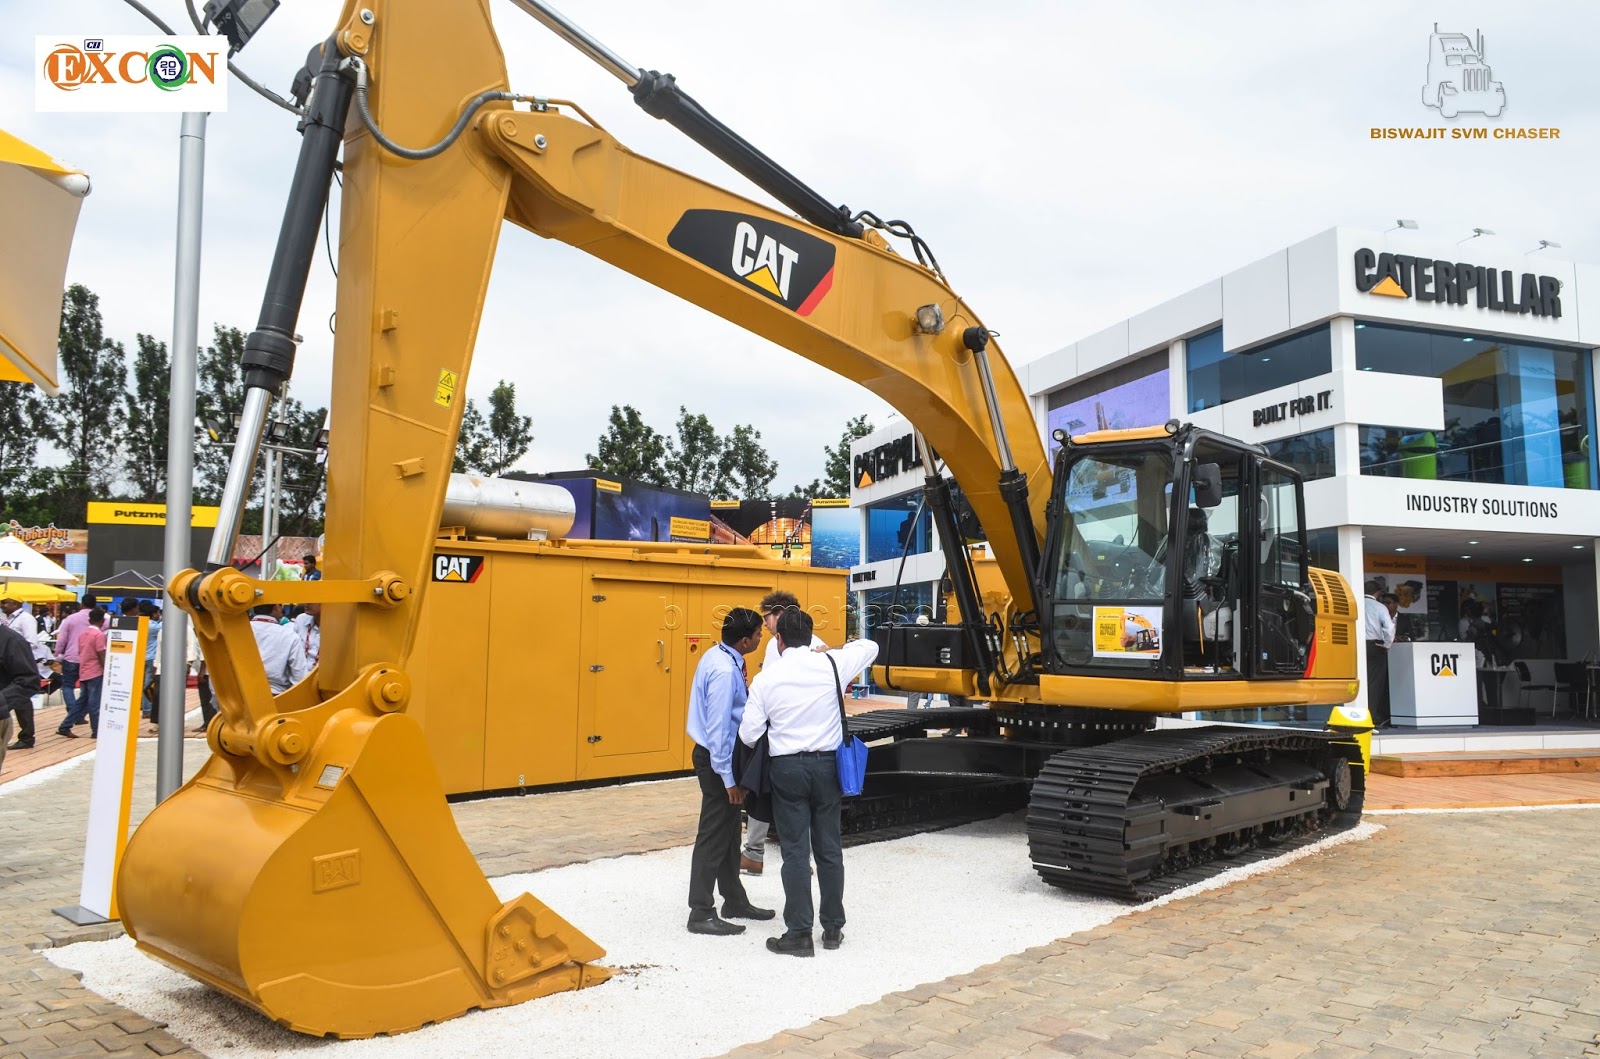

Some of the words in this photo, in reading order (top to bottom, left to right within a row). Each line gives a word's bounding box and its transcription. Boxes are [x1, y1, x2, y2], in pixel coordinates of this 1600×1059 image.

[731, 221, 799, 301] CAT
[1353, 247, 1562, 318] CATERPILLAR
[1252, 402, 1288, 427] BUILT
[1289, 395, 1315, 417] FOR
[1406, 494, 1478, 514] INDUSTRY
[1482, 498, 1558, 519] SOLUTIONS
[435, 555, 471, 581] CAT
[1430, 653, 1459, 677] CAT
